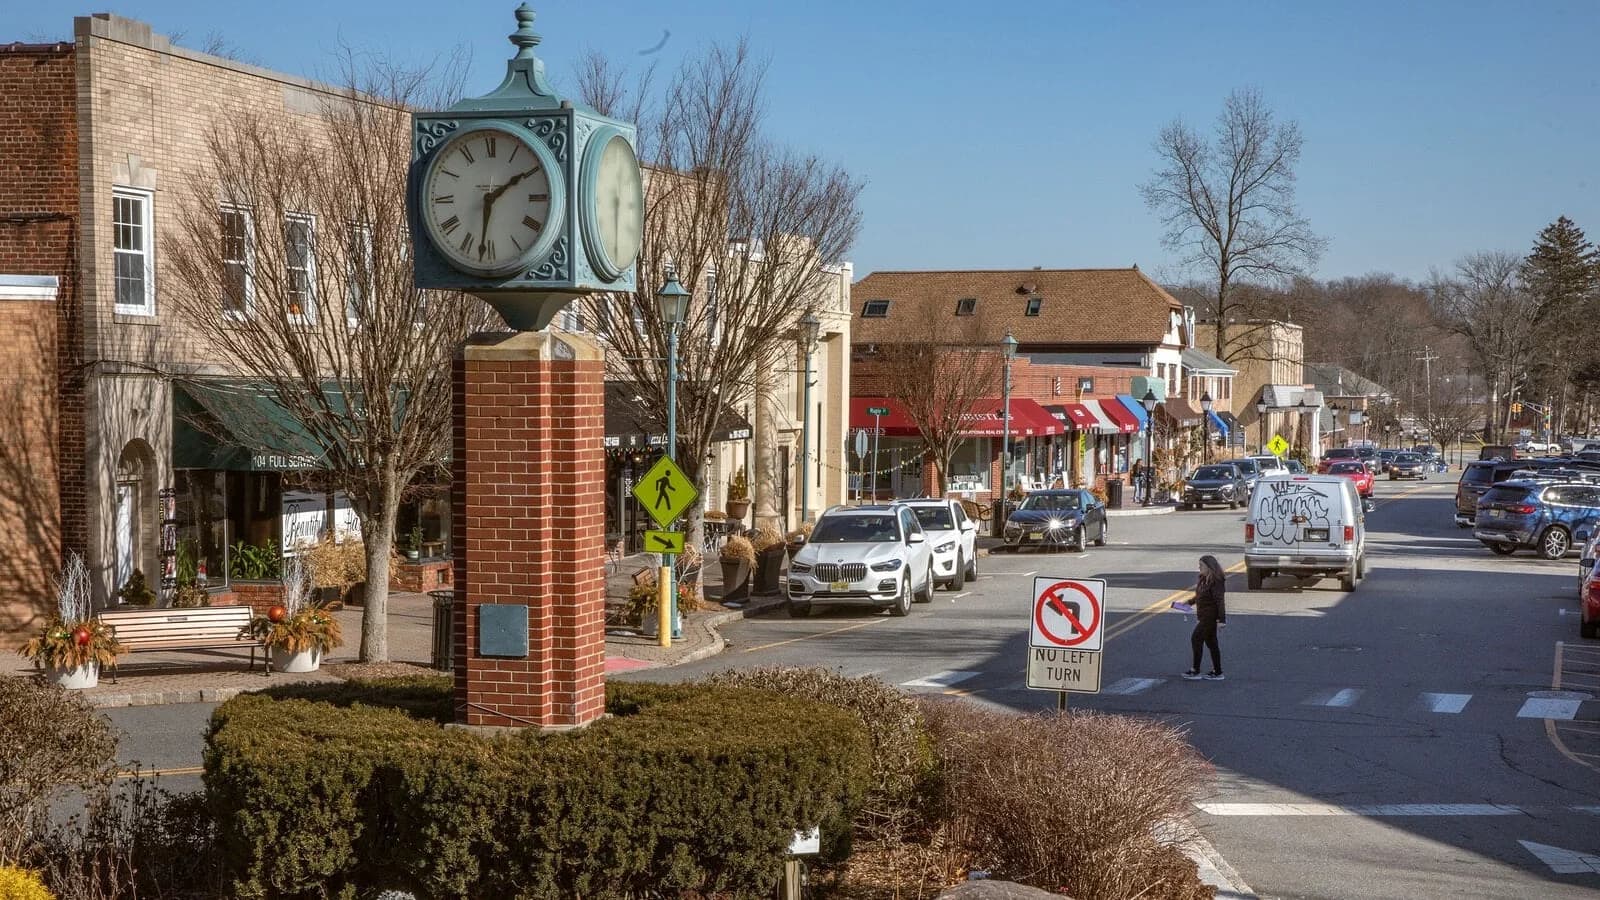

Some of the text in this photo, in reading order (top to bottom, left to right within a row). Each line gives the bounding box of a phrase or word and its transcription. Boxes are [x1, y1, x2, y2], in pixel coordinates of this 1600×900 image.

[253, 456, 266, 468] 104
[269, 456, 287, 468] FULL
[1036, 649, 1094, 664] NO LEFT
[1047, 667, 1081, 682] TURN
